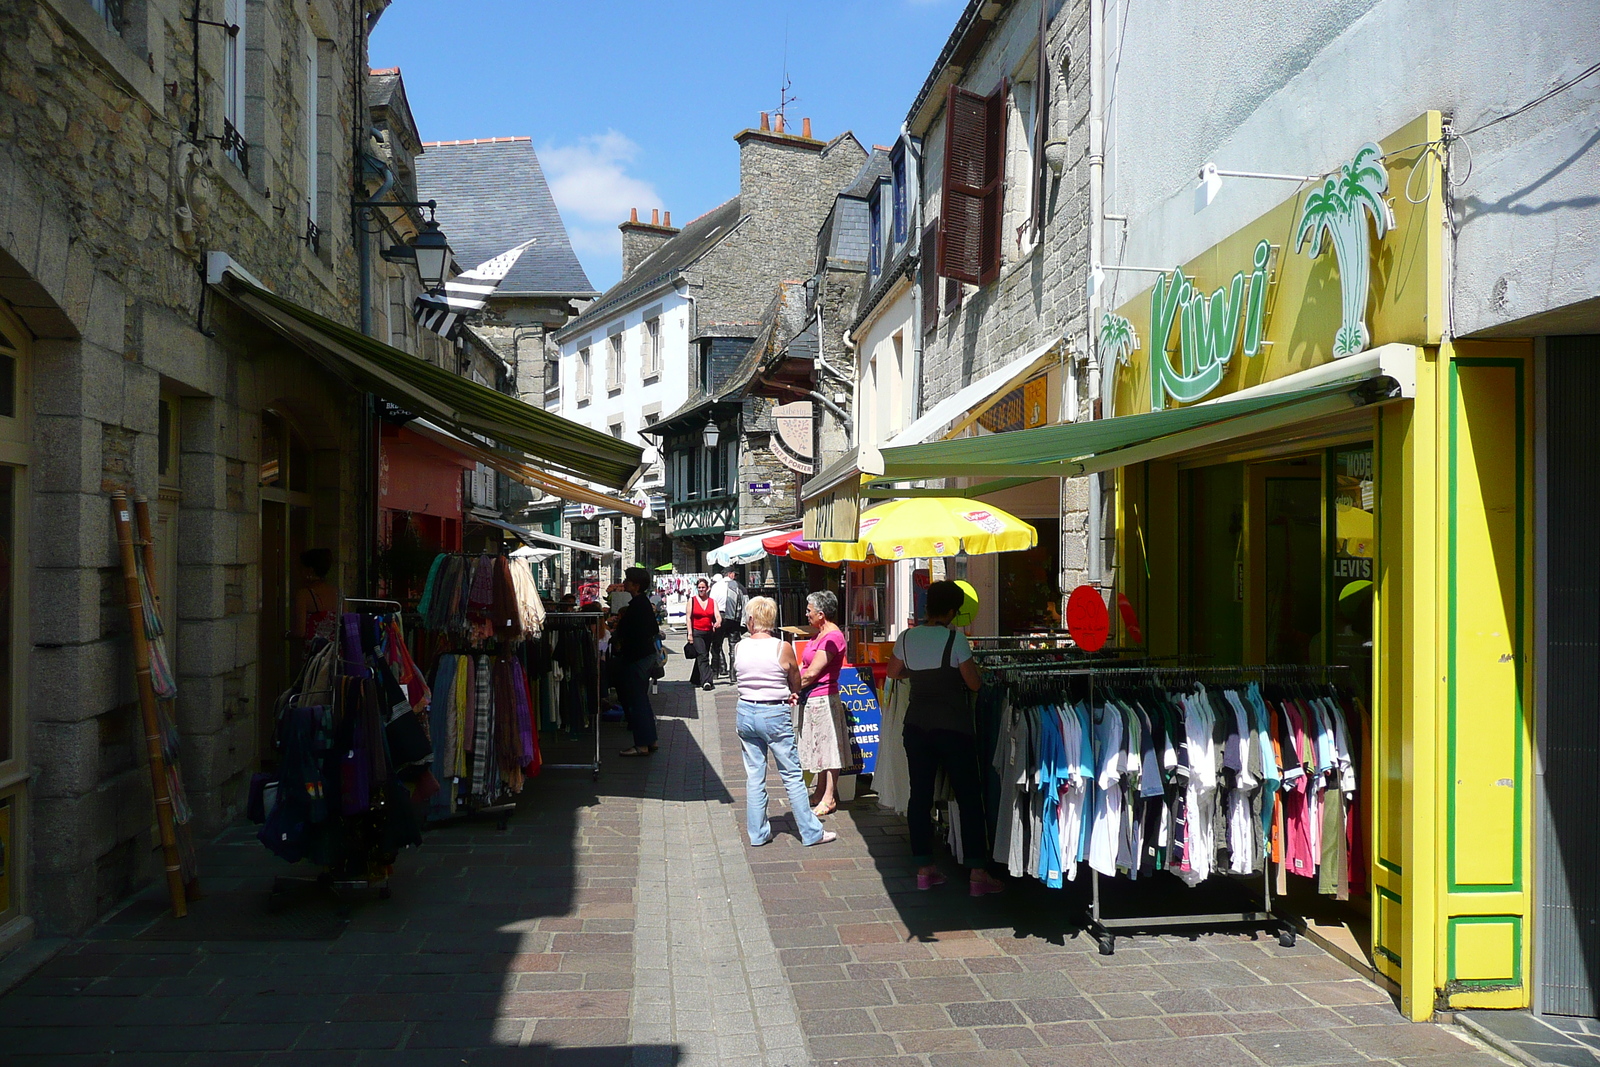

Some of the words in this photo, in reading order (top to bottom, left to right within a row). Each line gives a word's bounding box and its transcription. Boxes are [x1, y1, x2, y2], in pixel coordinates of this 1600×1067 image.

[1150, 239, 1270, 411] Kiwi
[788, 460, 811, 472] PORTER
[1333, 559, 1371, 578] LEVI'S
[838, 682, 870, 696] AFE
[846, 723, 879, 734] NBONS
[849, 734, 880, 745] AGEES
